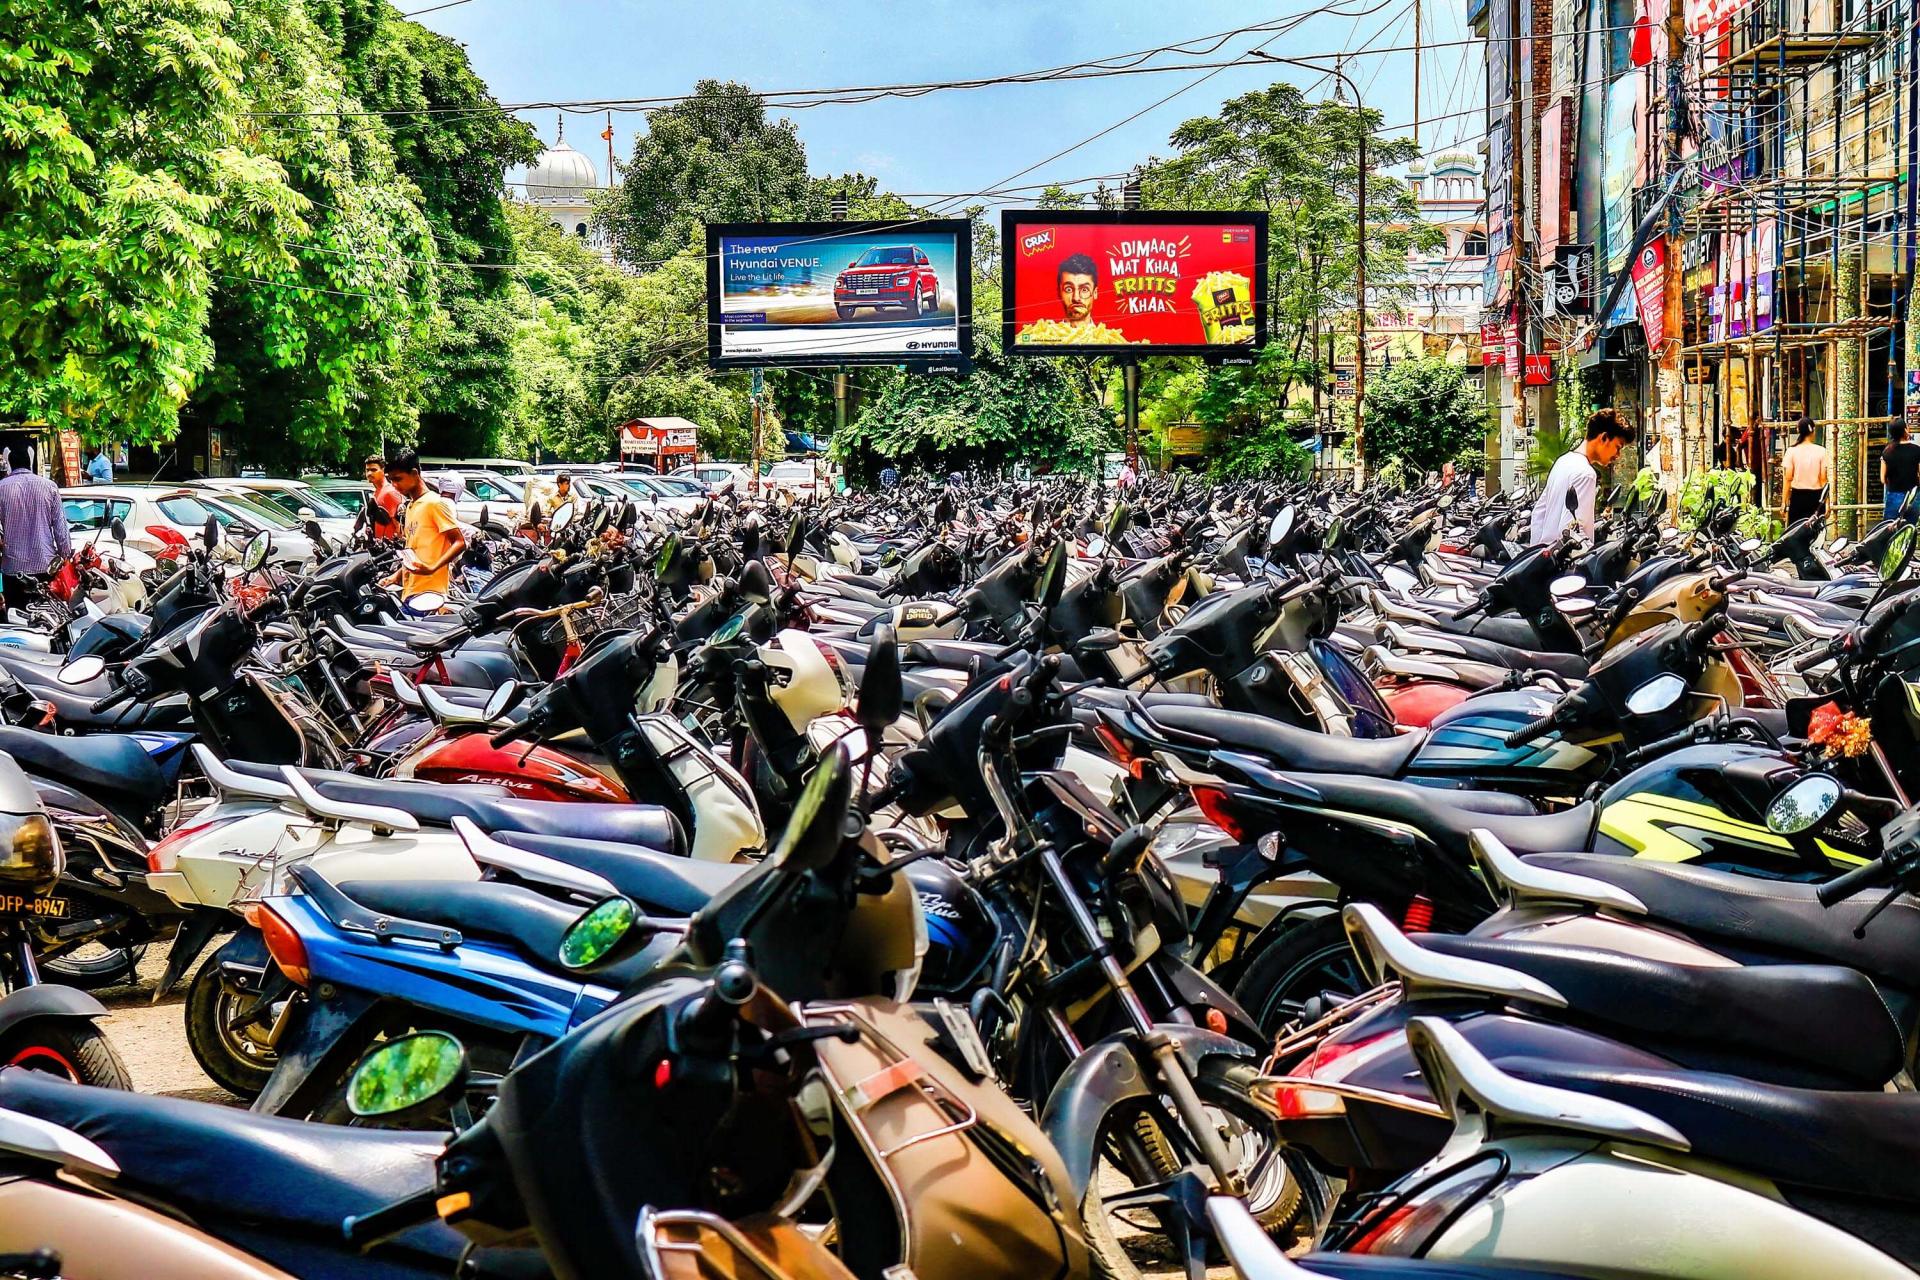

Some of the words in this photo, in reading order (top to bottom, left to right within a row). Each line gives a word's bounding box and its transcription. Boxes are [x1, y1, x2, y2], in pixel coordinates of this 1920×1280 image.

[1025, 232, 1051, 248] CRAX
[1121, 238, 1177, 258] DIMAAG
[730, 245, 751, 254] The
[754, 245, 778, 254] new
[1681, 232, 1712, 272] SUREY
[730, 258, 778, 270] Hyundai
[780, 257, 823, 268] VENUE.
[1110, 257, 1140, 276] MAT
[730, 273, 747, 281] Live
[748, 273, 761, 281] the
[773, 273, 785, 281] life
[1114, 276, 1177, 295] FRITTS
[1202, 301, 1252, 326] FRITTS
[921, 341, 957, 349] HYUNDAI
[1525, 365, 1548, 375] ATM
[457, 774, 533, 790] Activa
